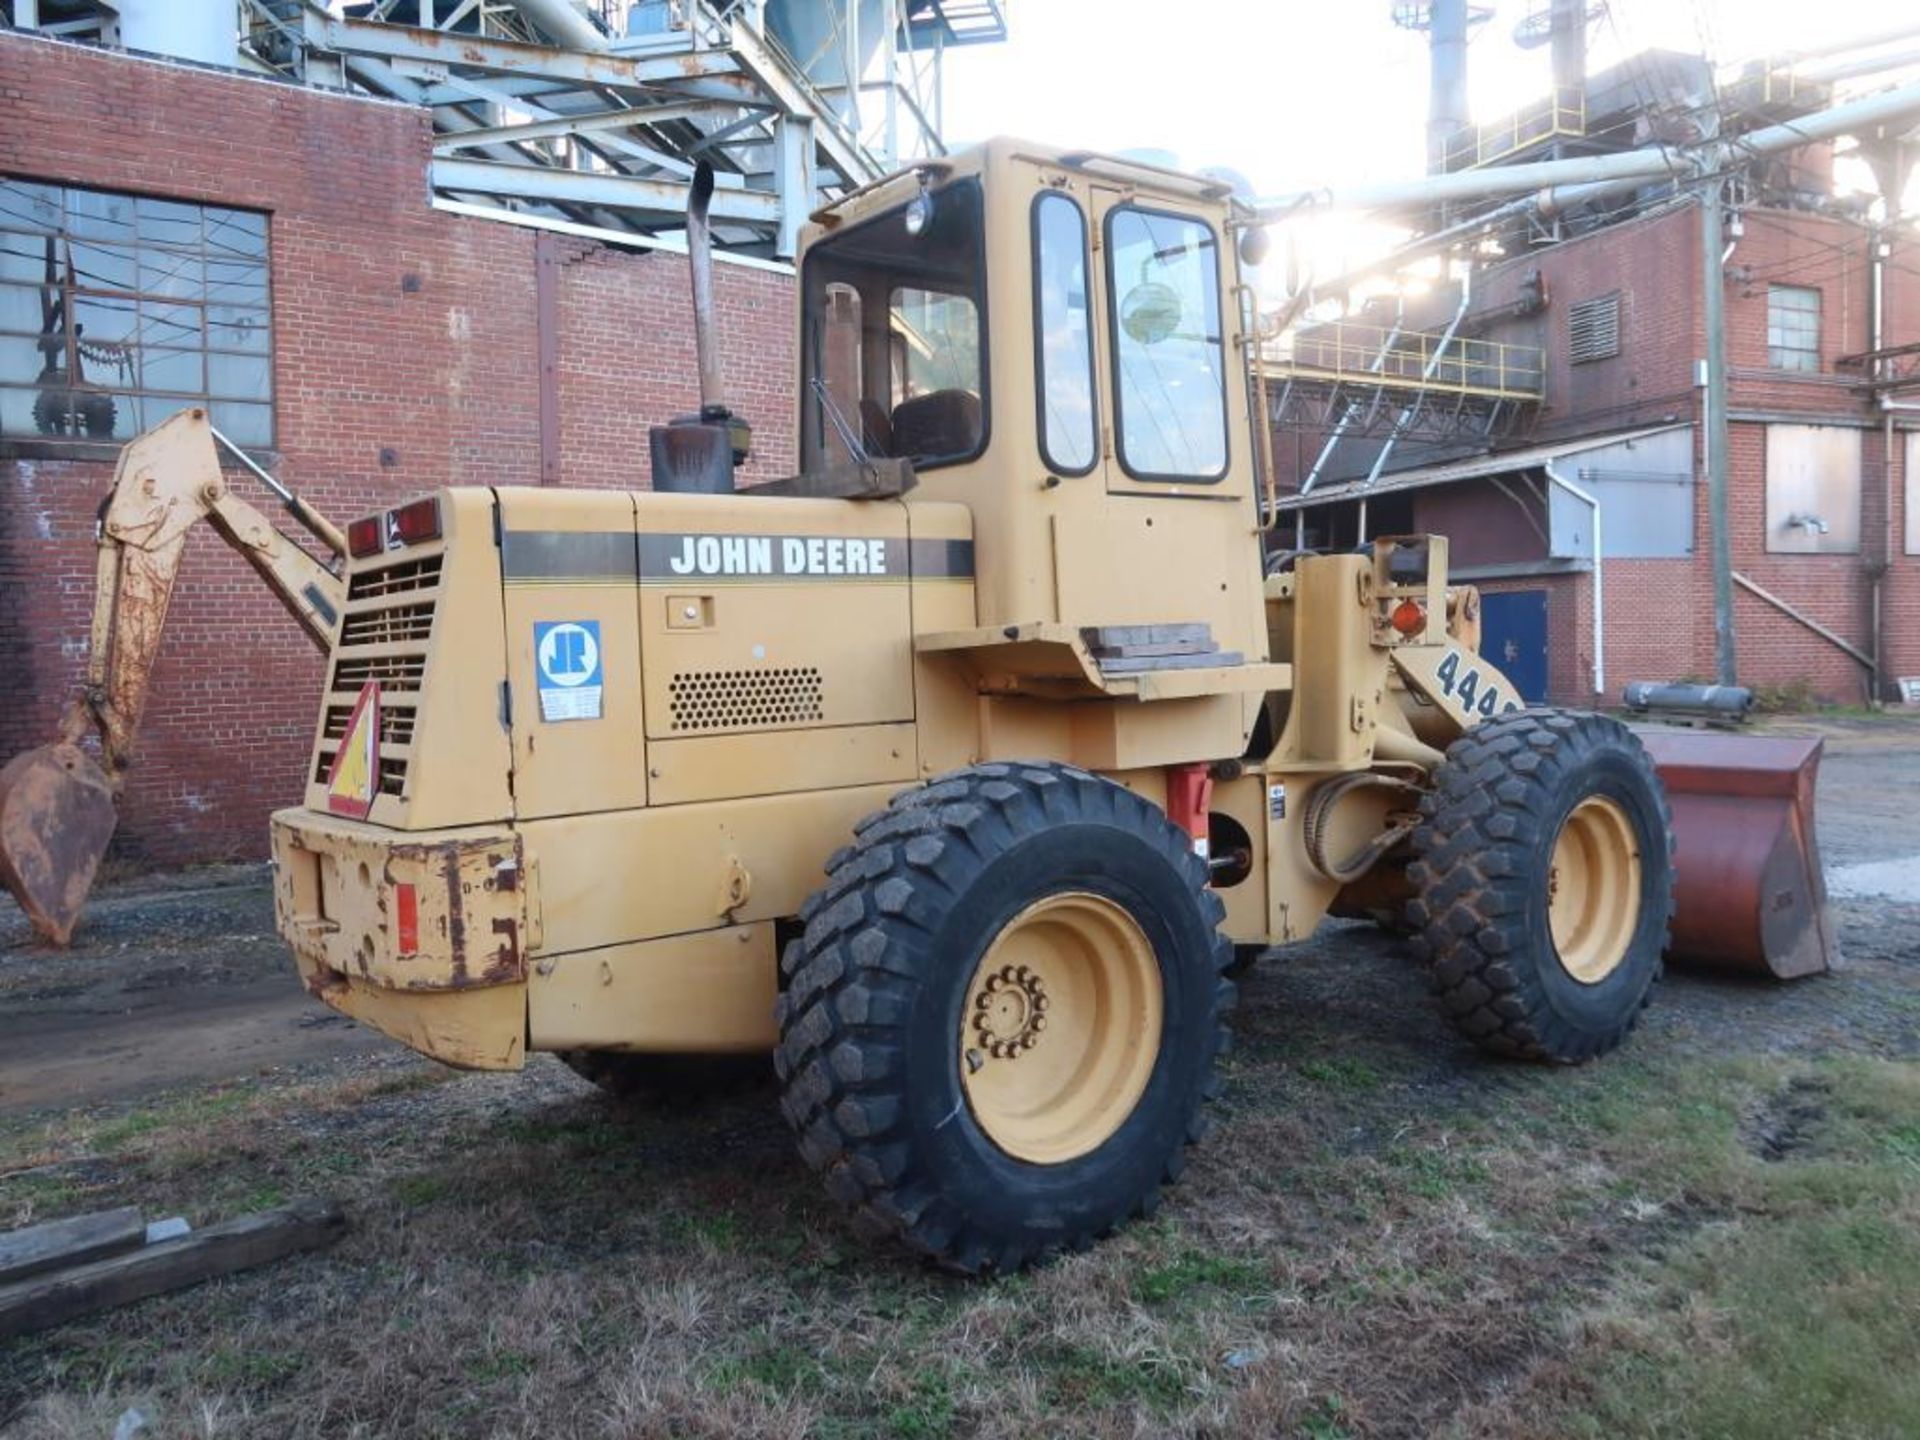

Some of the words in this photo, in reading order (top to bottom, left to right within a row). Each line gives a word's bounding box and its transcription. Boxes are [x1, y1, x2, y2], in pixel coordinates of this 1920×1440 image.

[670, 536, 772, 574] JOHN
[782, 538, 886, 574] DEERE
[548, 631, 588, 674] JR
[1436, 650, 1518, 716] 444
